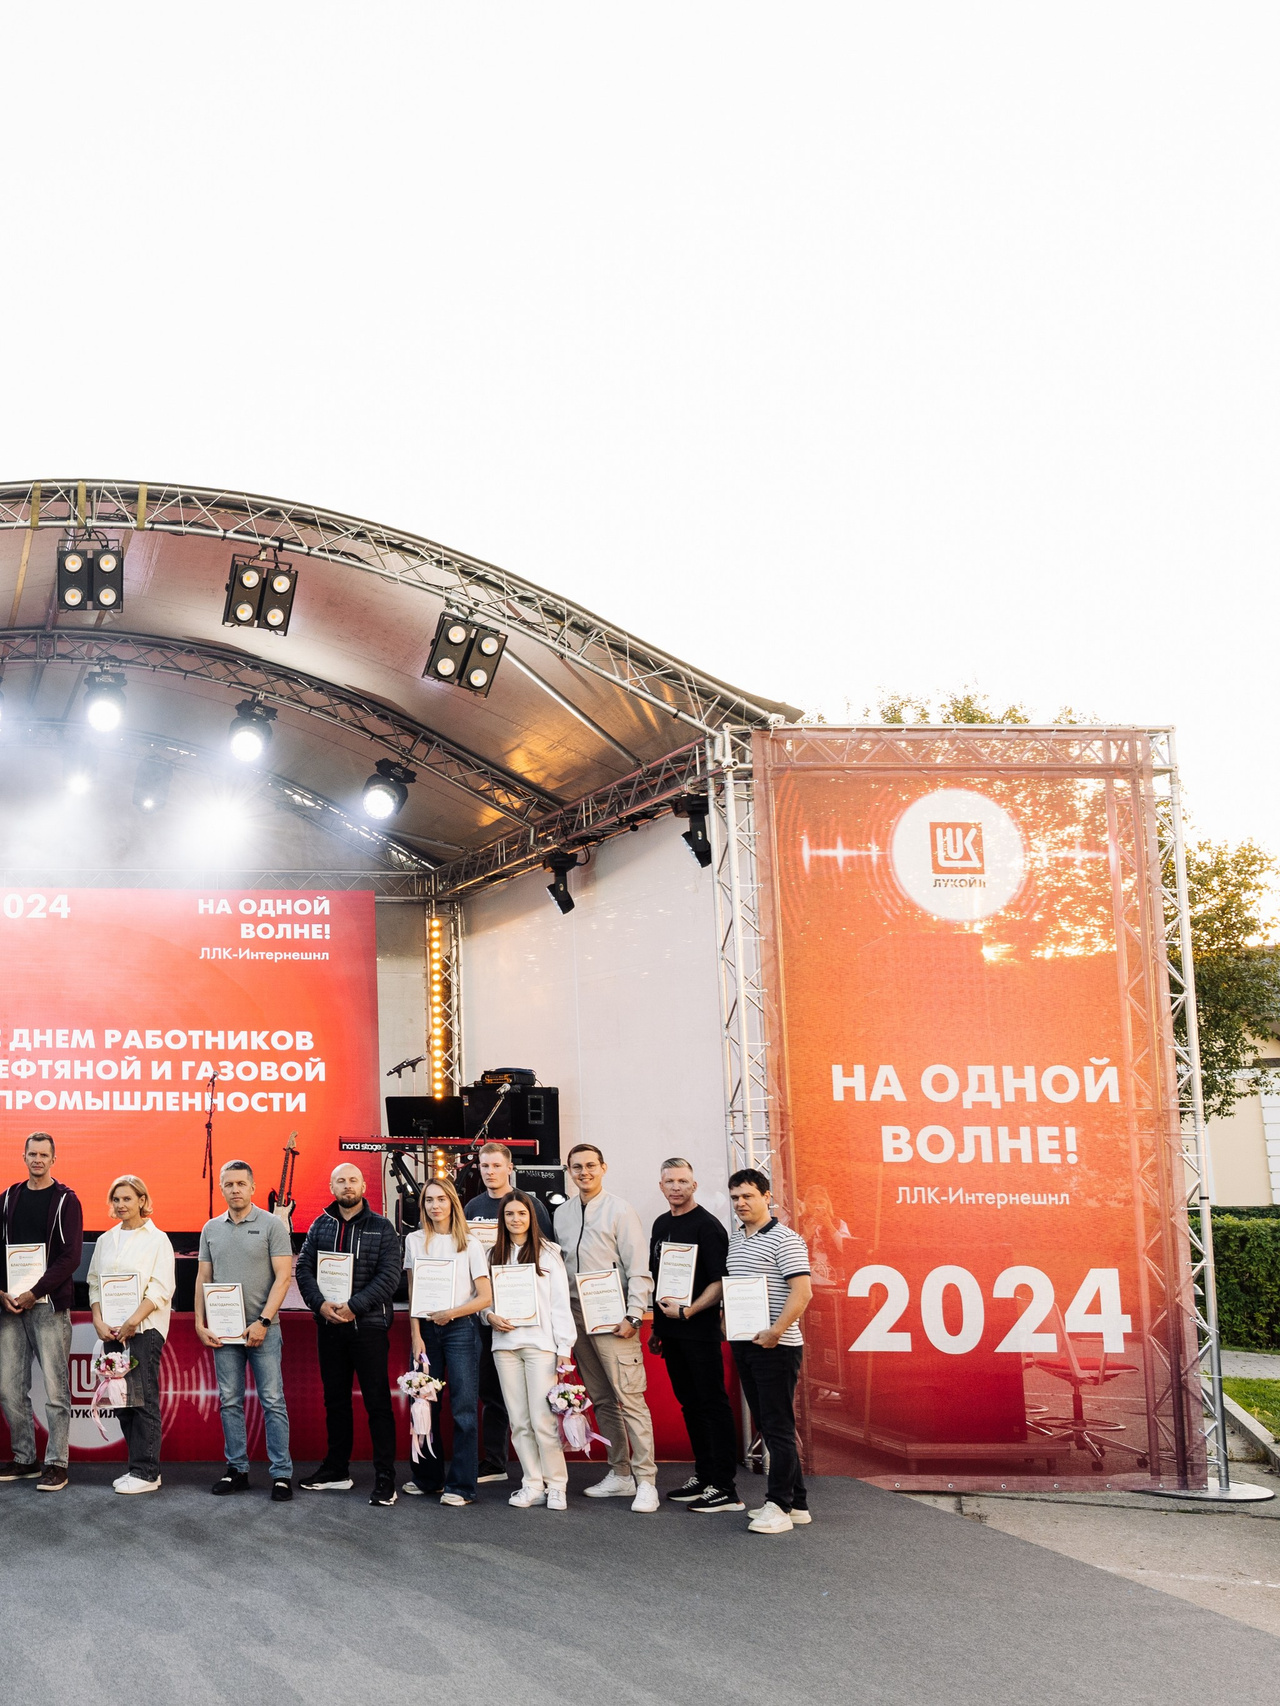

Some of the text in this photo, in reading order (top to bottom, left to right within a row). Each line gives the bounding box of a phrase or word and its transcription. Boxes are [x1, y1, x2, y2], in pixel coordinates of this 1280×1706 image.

[933, 877, 986, 888] ЛУКОЙЛ
[198, 896, 330, 918] НА ОДНОЙ
[240, 923, 330, 940] ВОЛНЕ!
[199, 947, 330, 963] ЛЛК-Интернешнл
[10, 1029, 96, 1051] ДНЕМ
[105, 1029, 314, 1051] РАБОТНИКОВ
[152, 1060, 172, 1081] И
[182, 1057, 326, 1082] ГАЗОВОЙ
[831, 1057, 1120, 1109] НА ОДНОЙ
[881, 1125, 1078, 1164] ВОЛНЕ!
[896, 1187, 1070, 1209] ЛЛК-Интернешнл
[847, 1264, 1132, 1355] 2024
